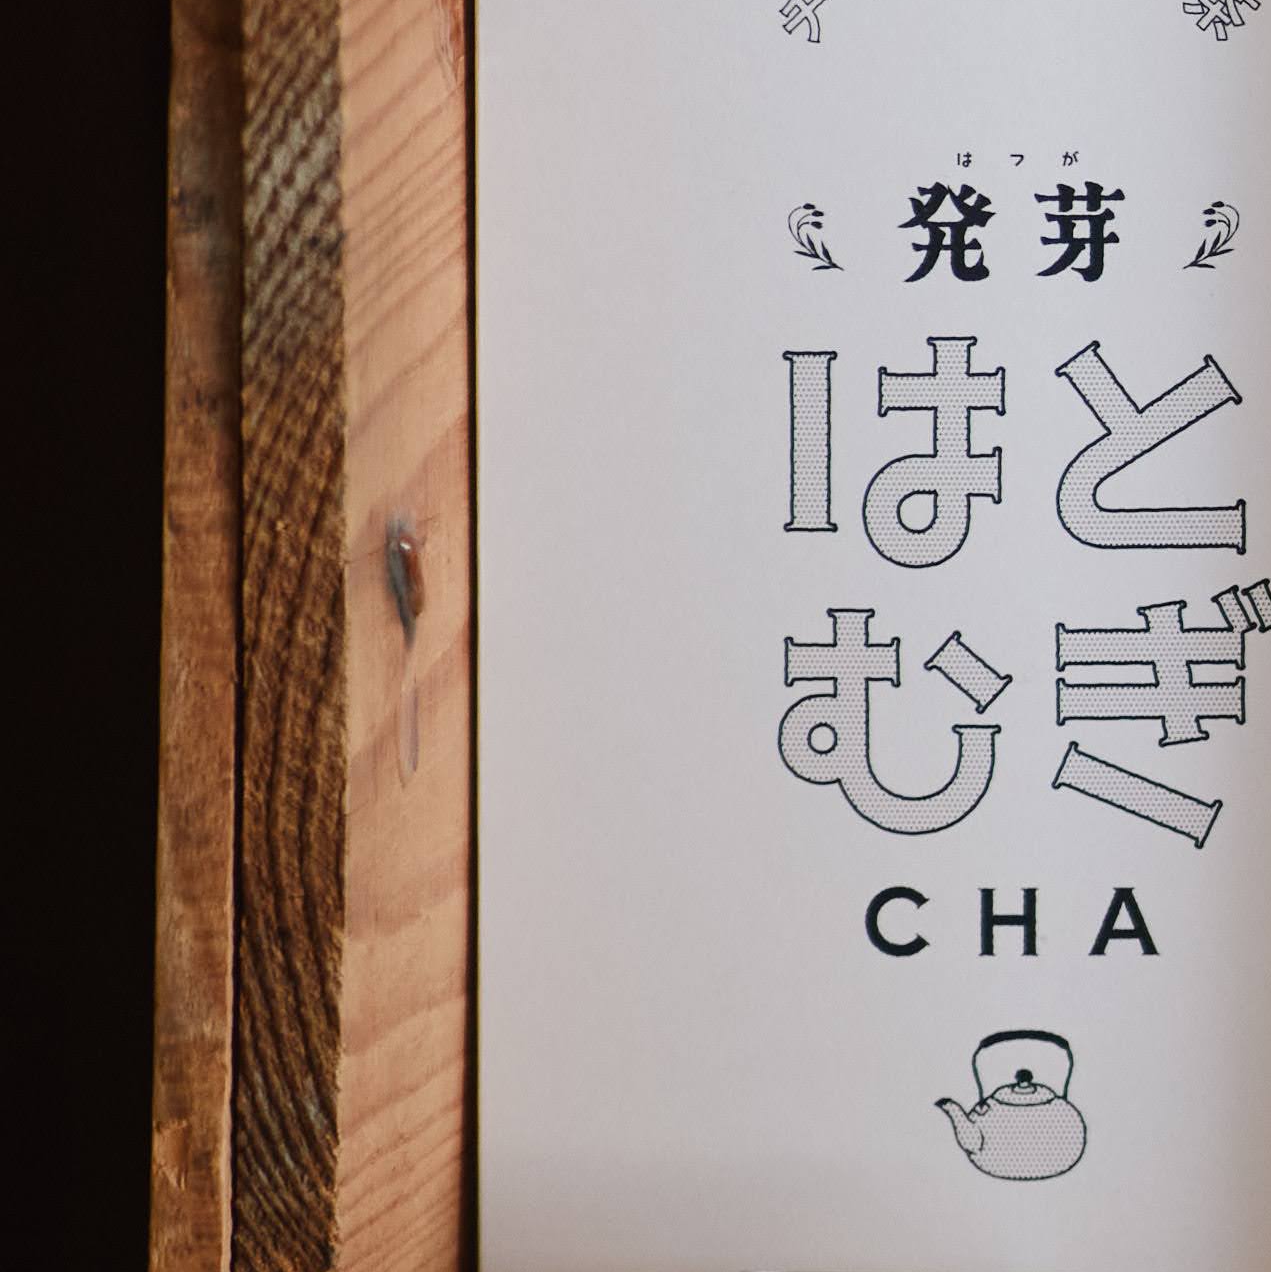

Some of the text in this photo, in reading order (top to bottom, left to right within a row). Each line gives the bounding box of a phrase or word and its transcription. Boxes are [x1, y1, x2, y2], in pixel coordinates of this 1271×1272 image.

[897, 180, 1126, 283] 発芽
[781, 335, 1247, 570] はと
[864, 885, 1160, 958] CHA
